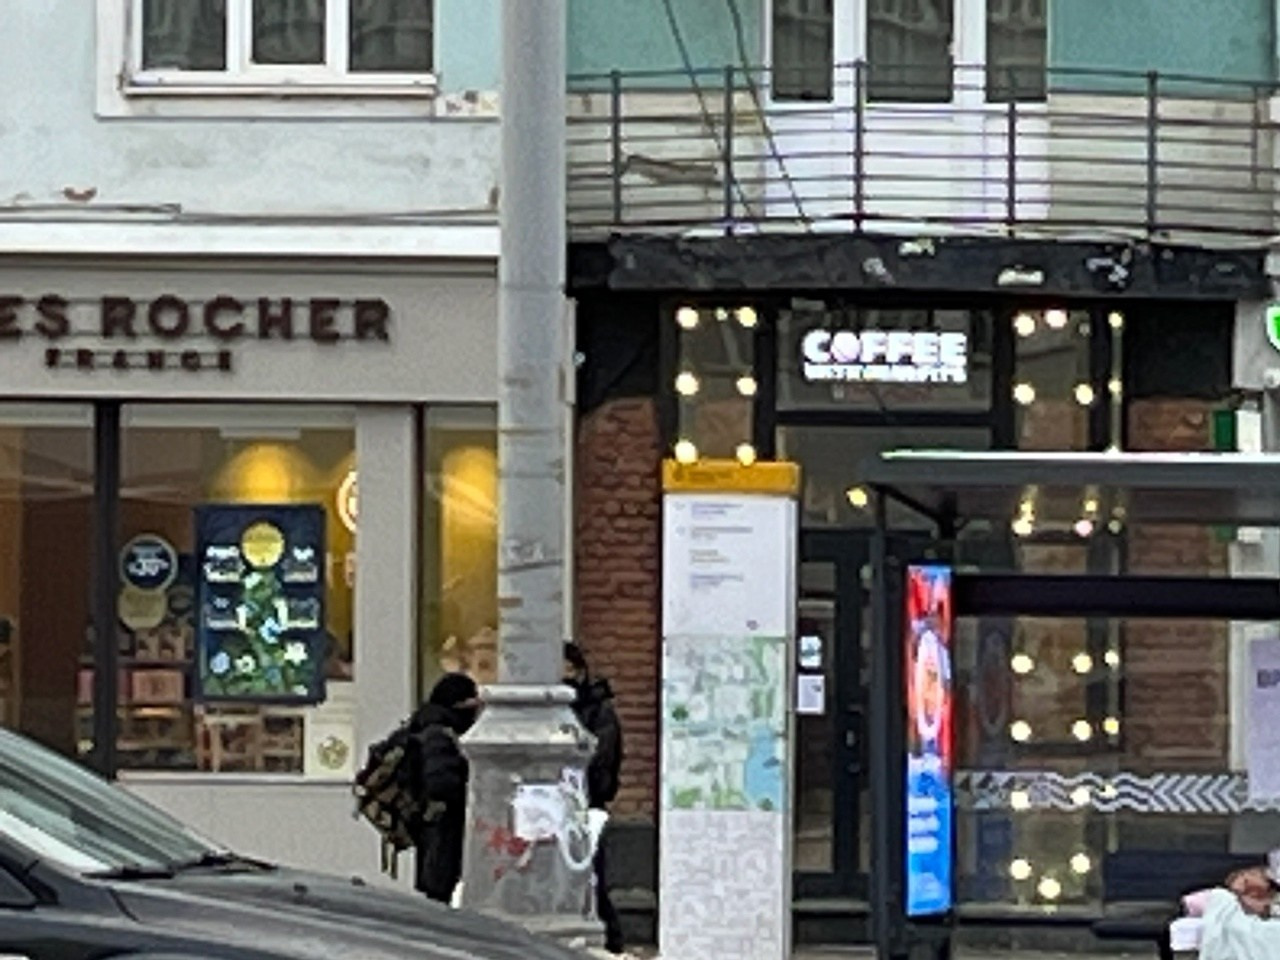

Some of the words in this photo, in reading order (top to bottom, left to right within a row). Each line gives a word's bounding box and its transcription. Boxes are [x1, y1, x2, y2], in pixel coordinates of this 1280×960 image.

[102, 293, 390, 342] ROCHER
[45, 348, 233, 370] FRANCE
[802, 329, 968, 366] COFFEE
